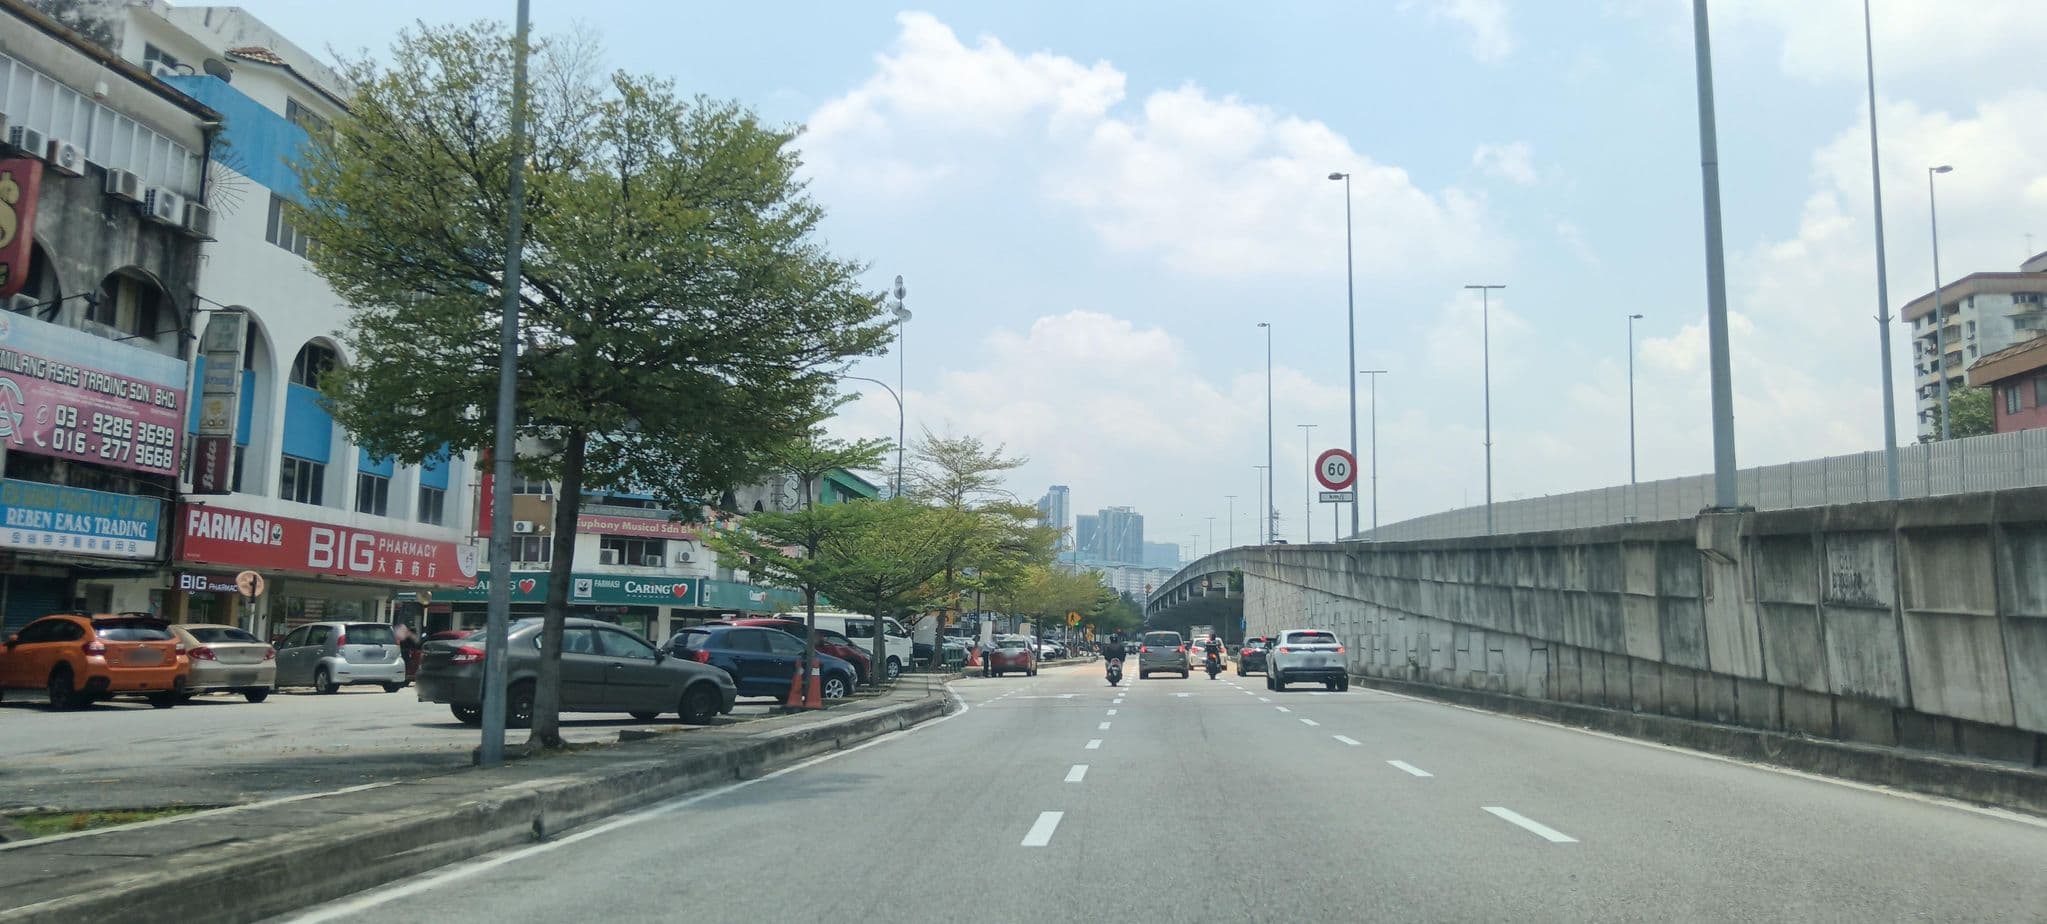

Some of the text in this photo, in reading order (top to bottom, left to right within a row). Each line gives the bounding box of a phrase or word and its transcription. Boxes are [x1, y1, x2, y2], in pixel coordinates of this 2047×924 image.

[0, 350, 47, 379] MILANG
[48, 361, 80, 387] ASAS
[82, 370, 128, 398] TRADING
[155, 388, 177, 410] BHD.
[55, 404, 78, 428] 03
[92, 412, 133, 439] 9285
[137, 422, 175, 447] 3699
[52, 430, 174, 469] 016 277 9668
[202, 439, 217, 490] Bata
[1328, 462, 1346, 476] 60
[6, 507, 148, 538] REBEN EMAS TRADING
[188, 510, 270, 545] FARMASI
[622, 521, 659, 533] Musical
[661, 523, 679, 534] Sdn
[308, 526, 376, 573] BIG
[378, 537, 438, 558] PHARMACY
[180, 574, 240, 592] BIG PHARMAC
[593, 578, 621, 589] FARMASI
